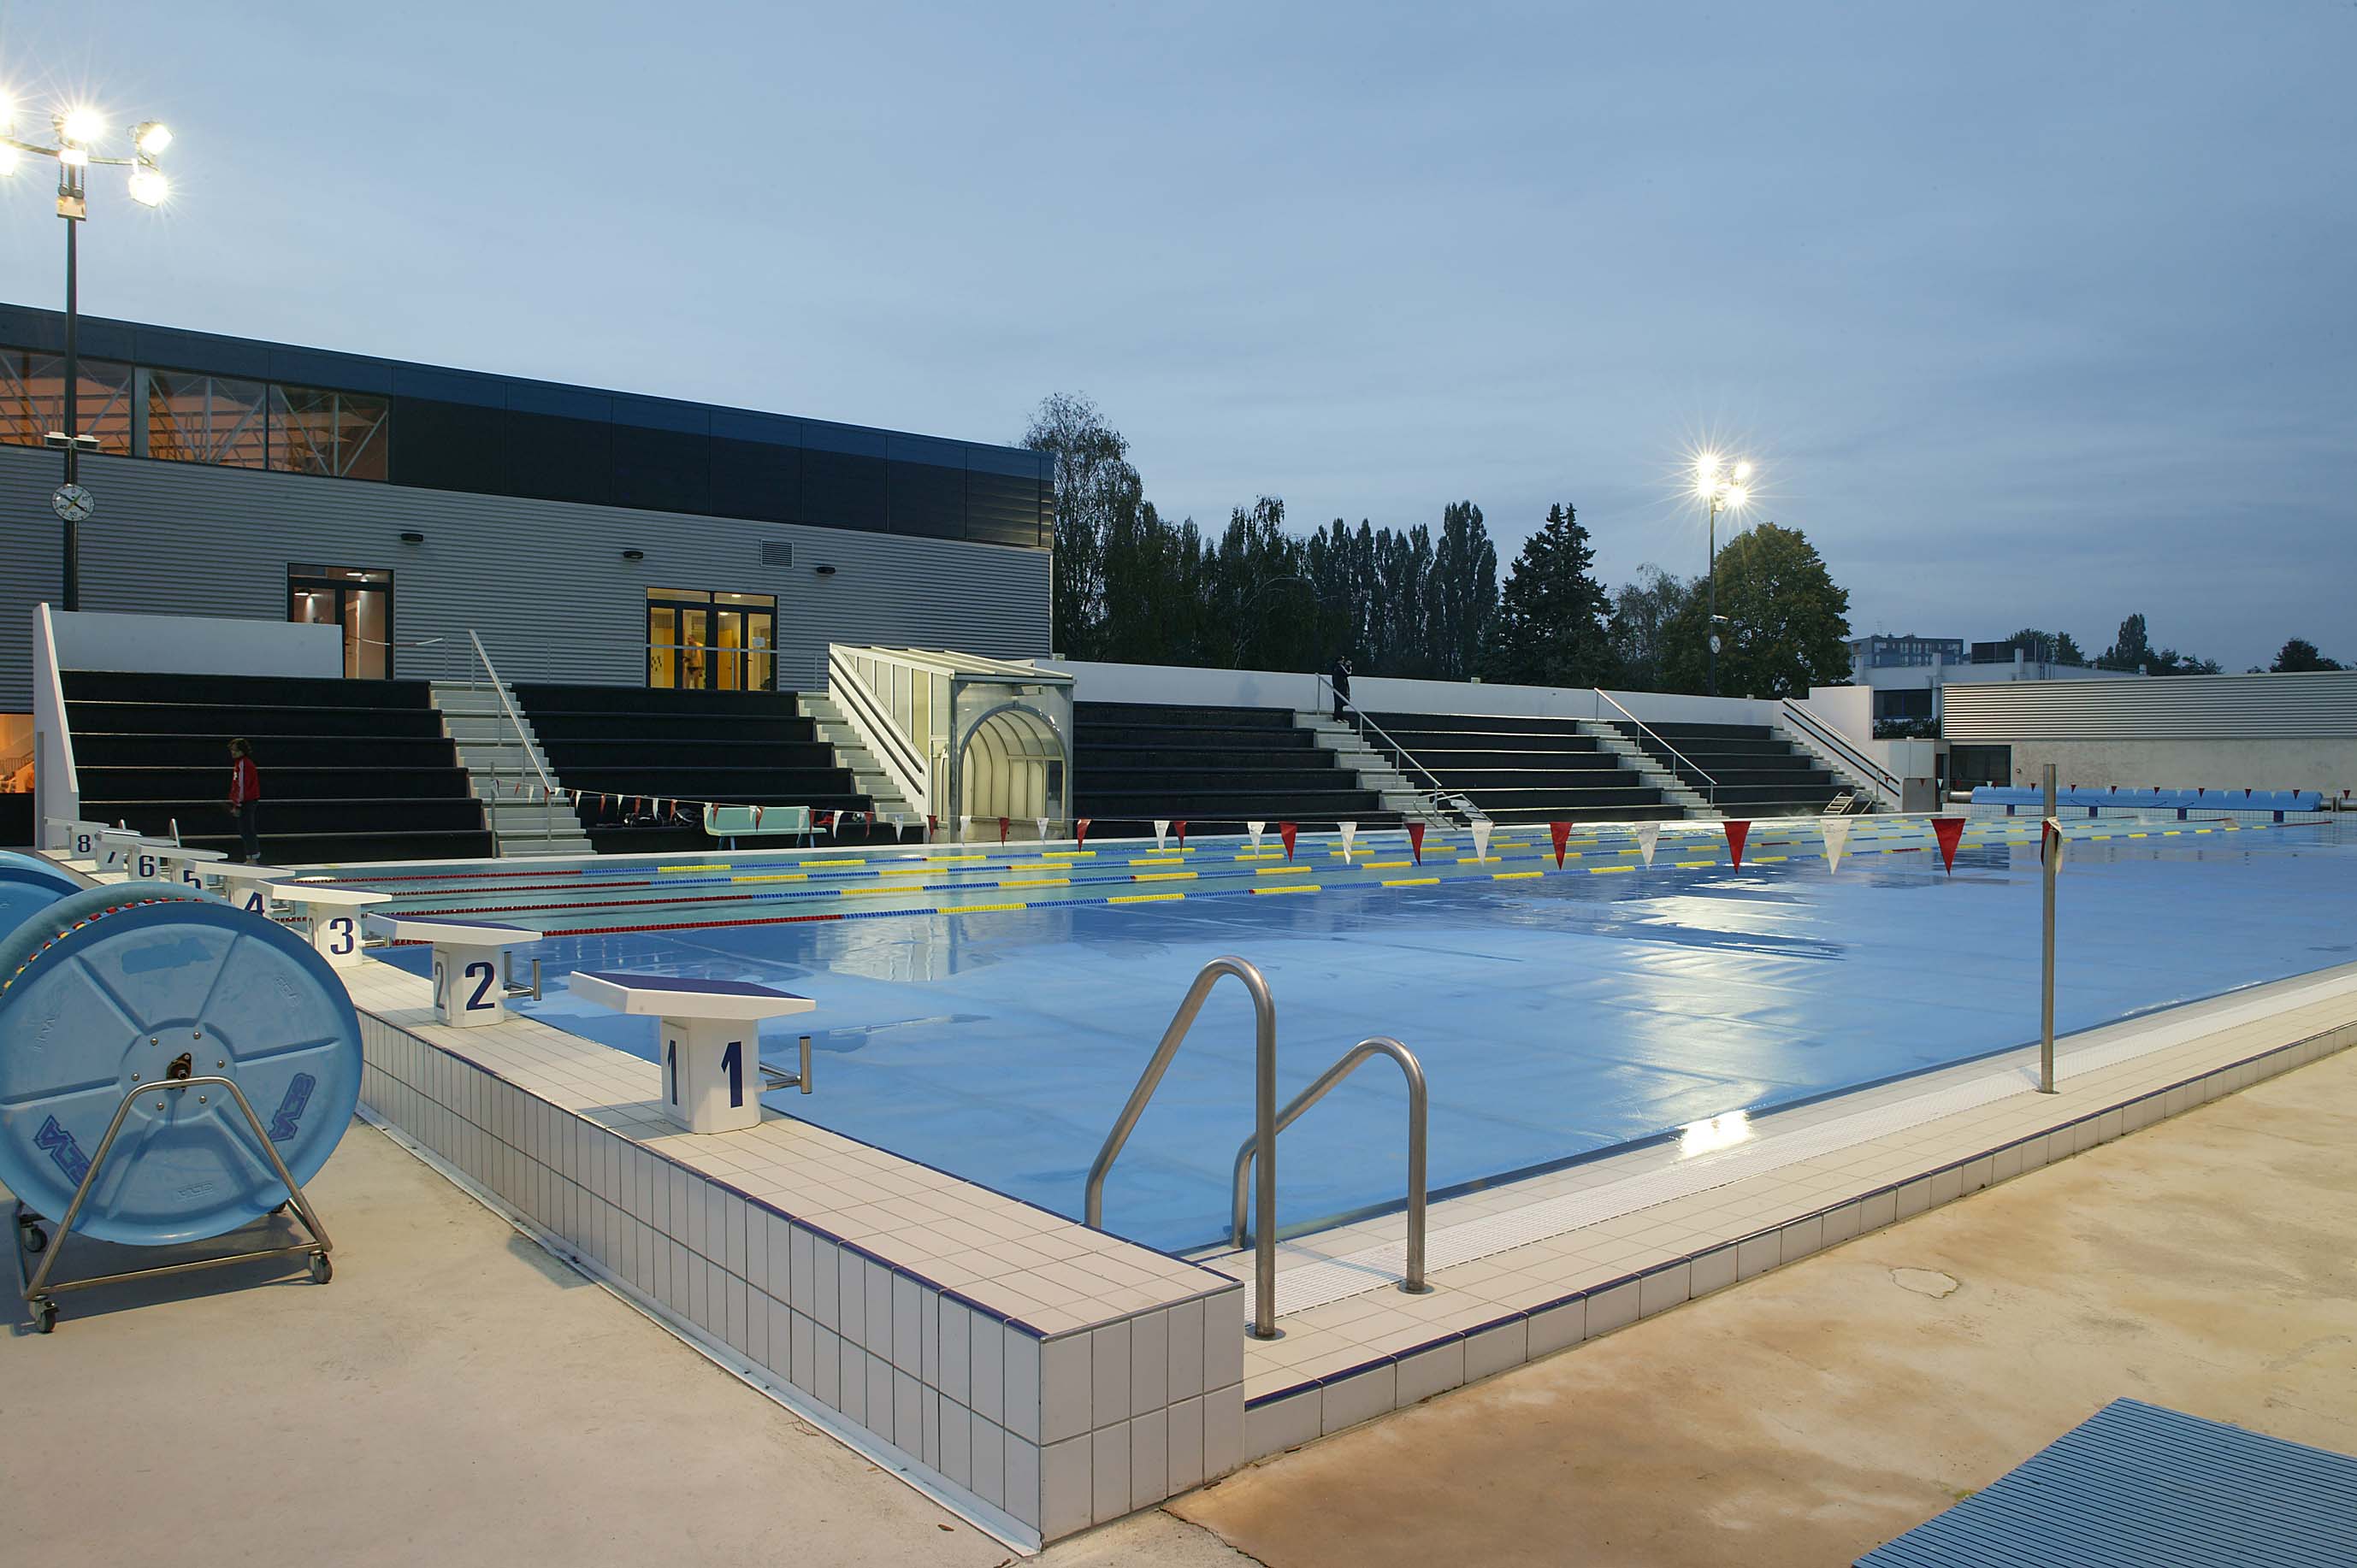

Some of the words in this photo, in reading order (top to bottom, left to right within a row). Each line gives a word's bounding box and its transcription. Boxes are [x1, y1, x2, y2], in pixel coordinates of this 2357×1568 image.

[78, 834, 91, 853] 8
[139, 855, 155, 878] 6
[244, 892, 265, 917] 4
[329, 917, 354, 955] 3
[434, 961, 446, 1010] 2
[464, 961, 495, 1011] 2
[667, 1039, 678, 1106] 1
[721, 1040, 743, 1109] 1
